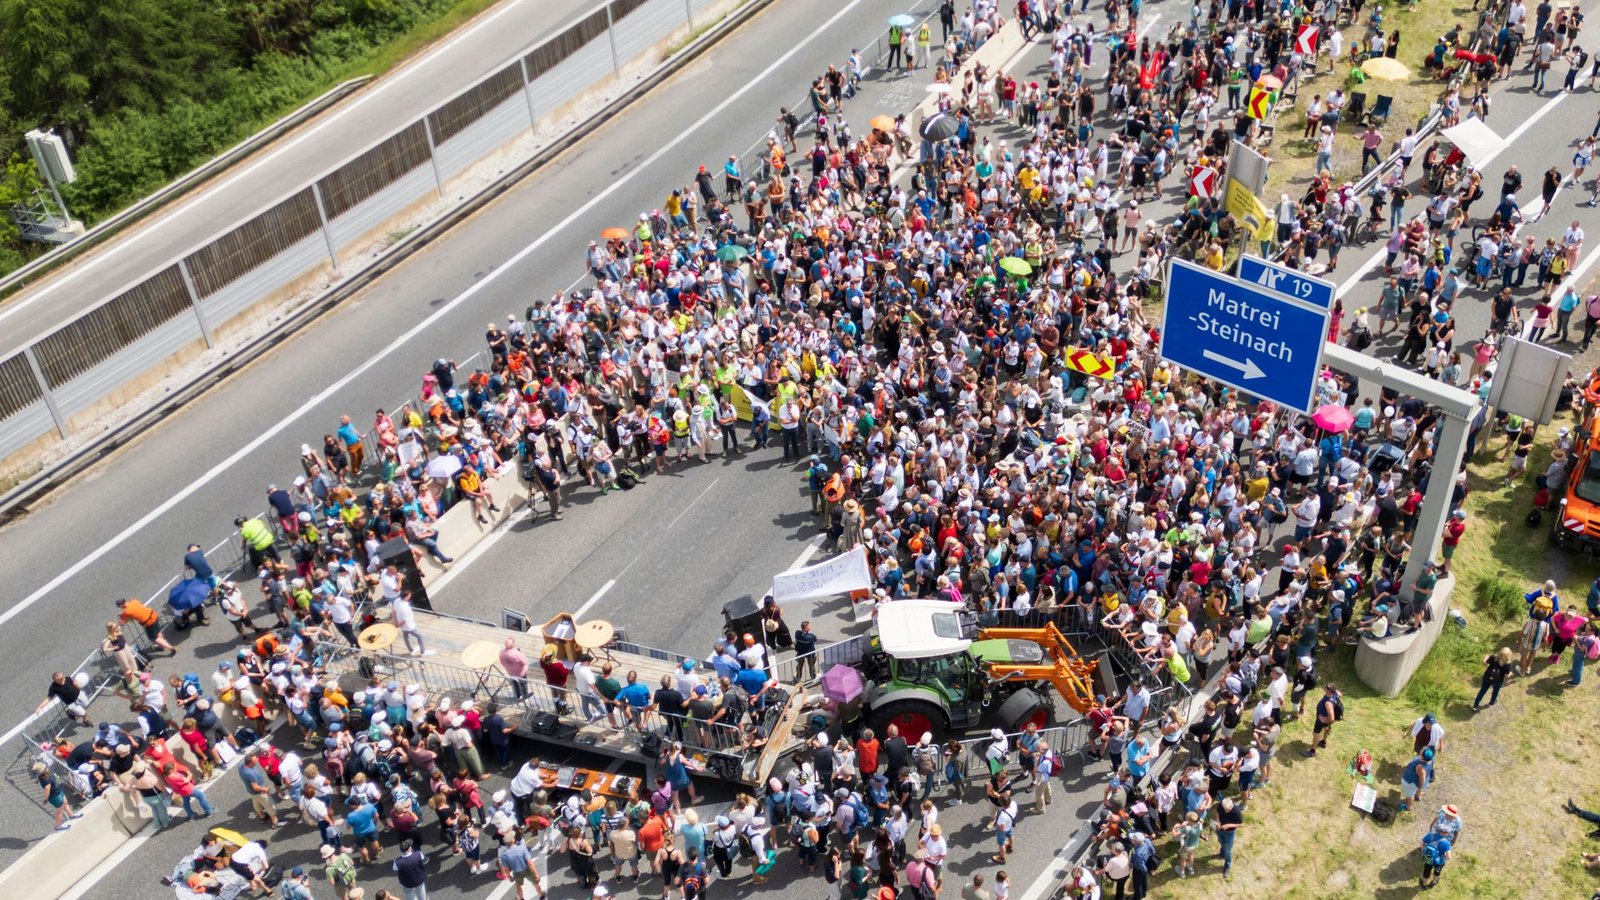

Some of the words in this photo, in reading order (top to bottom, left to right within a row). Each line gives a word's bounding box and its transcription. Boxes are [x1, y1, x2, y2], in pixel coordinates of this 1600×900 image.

[1207, 288, 1280, 330] Matrei
[1293, 279, 1313, 298] 19
[1189, 312, 1293, 363] -Steinach
